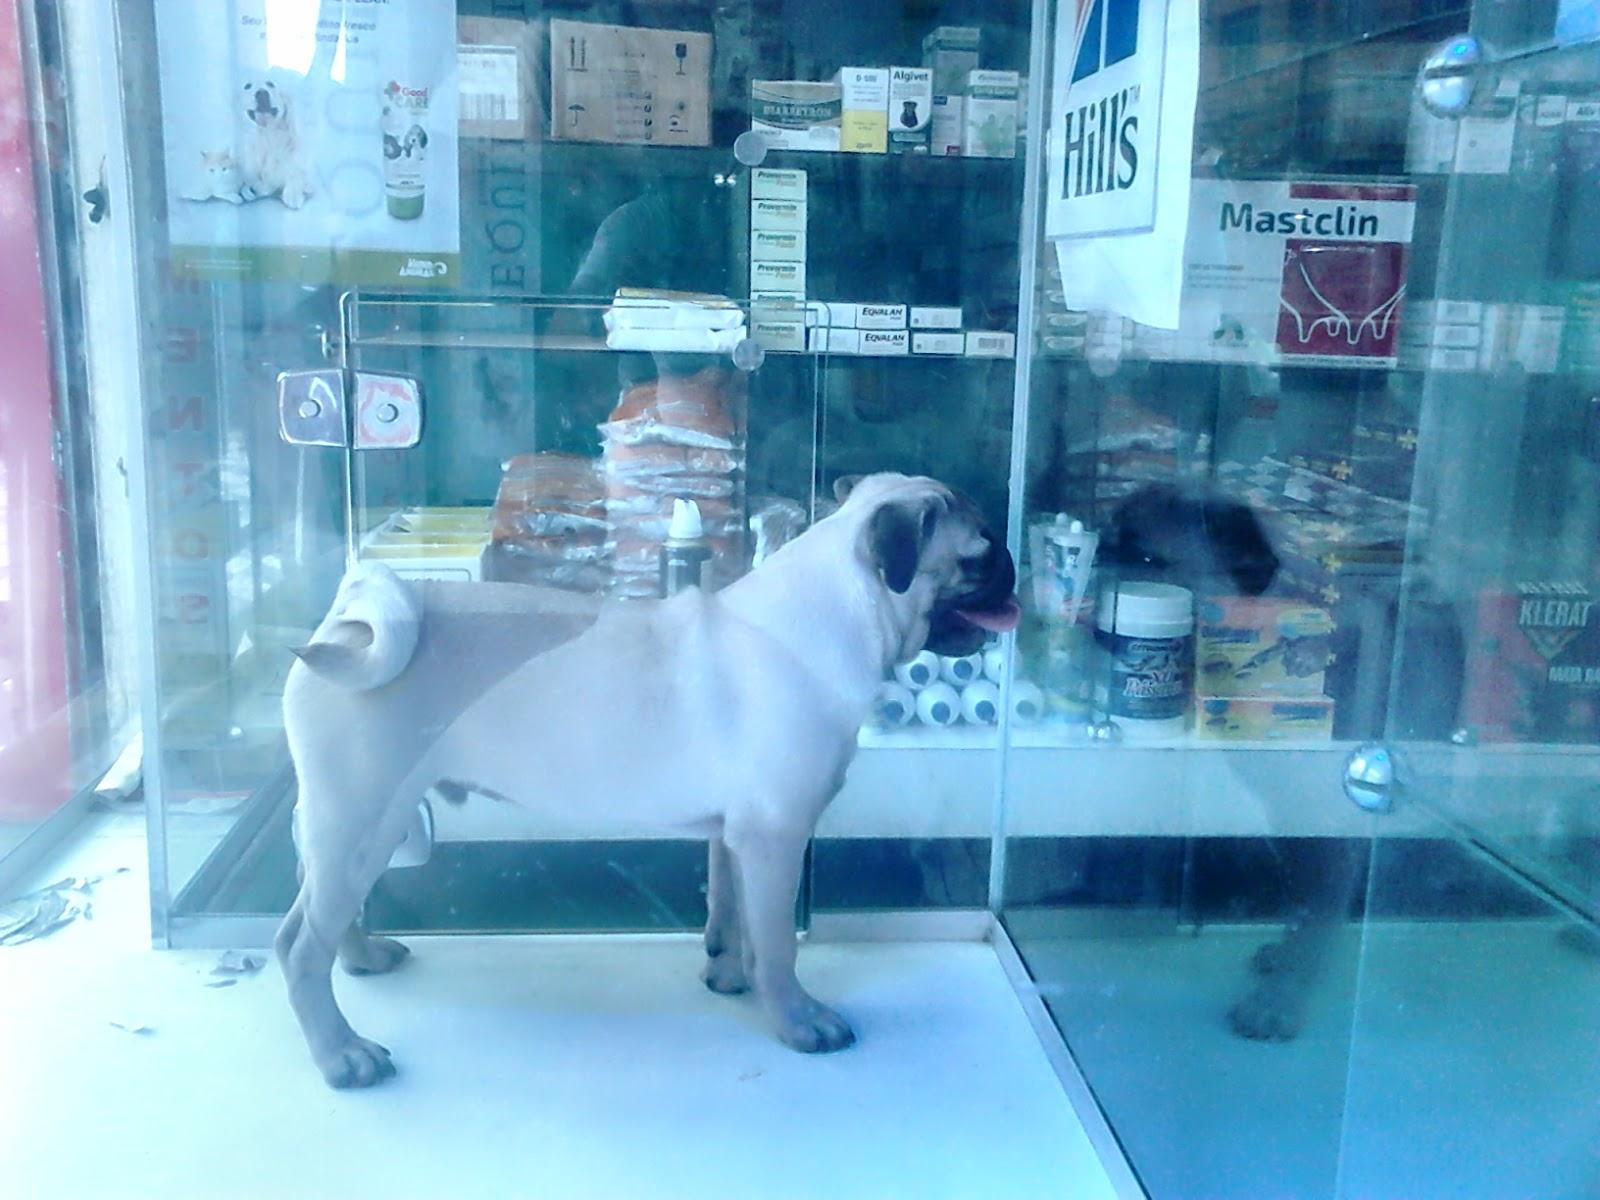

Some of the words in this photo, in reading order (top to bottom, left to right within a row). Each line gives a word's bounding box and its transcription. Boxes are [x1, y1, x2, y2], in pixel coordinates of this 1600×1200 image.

[893, 71, 929, 82] Algivet
[1061, 88, 1139, 200] Hill's
[1219, 201, 1380, 237] Mastclin
[862, 307, 904, 316] EQVALAN
[865, 333, 906, 342] EQVALAN
[1519, 600, 1593, 626] KLERAT
